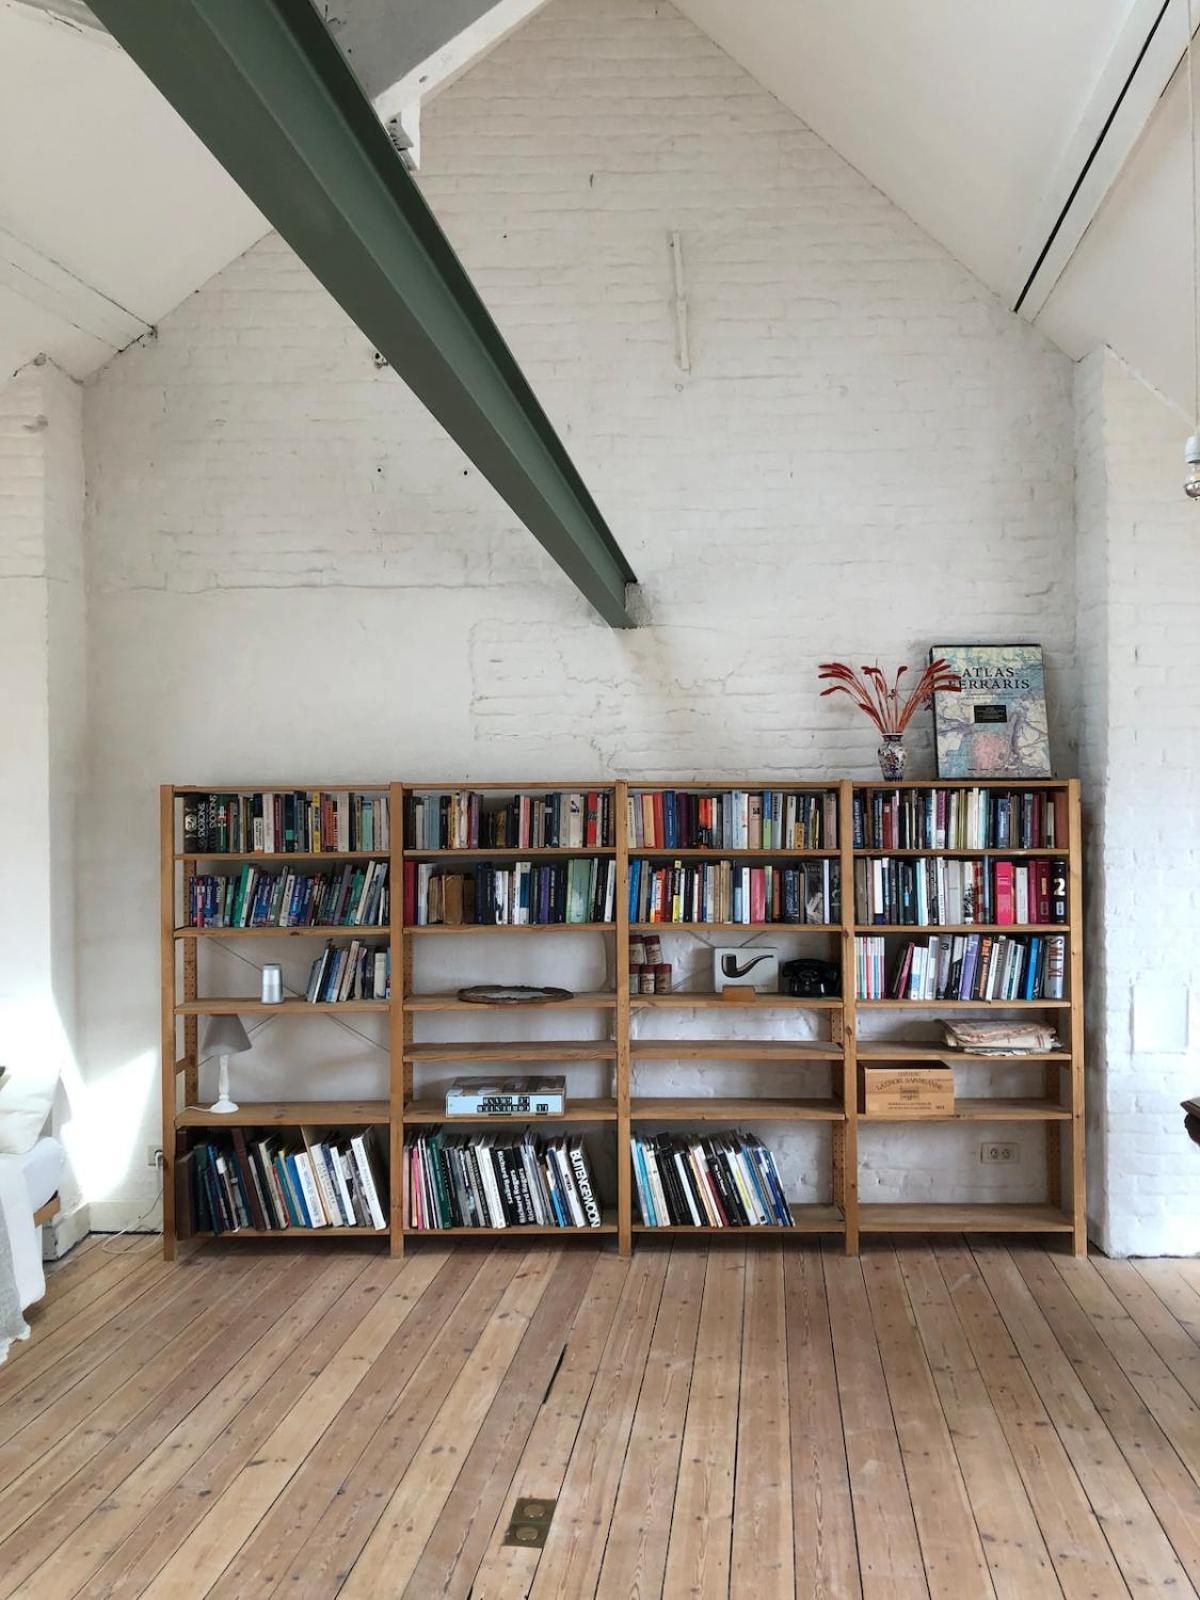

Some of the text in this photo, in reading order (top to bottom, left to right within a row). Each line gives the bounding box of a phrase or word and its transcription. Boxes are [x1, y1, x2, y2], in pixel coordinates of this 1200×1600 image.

[962, 667, 1015, 678] ATLAS
[1053, 878, 1066, 895] 2
[497, 1151, 509, 1178] Richard
[510, 1169, 526, 1223] Richard Rogers
[518, 1168, 535, 1222] Richard Rogers
[569, 1150, 601, 1228] BUITENGEWOON
